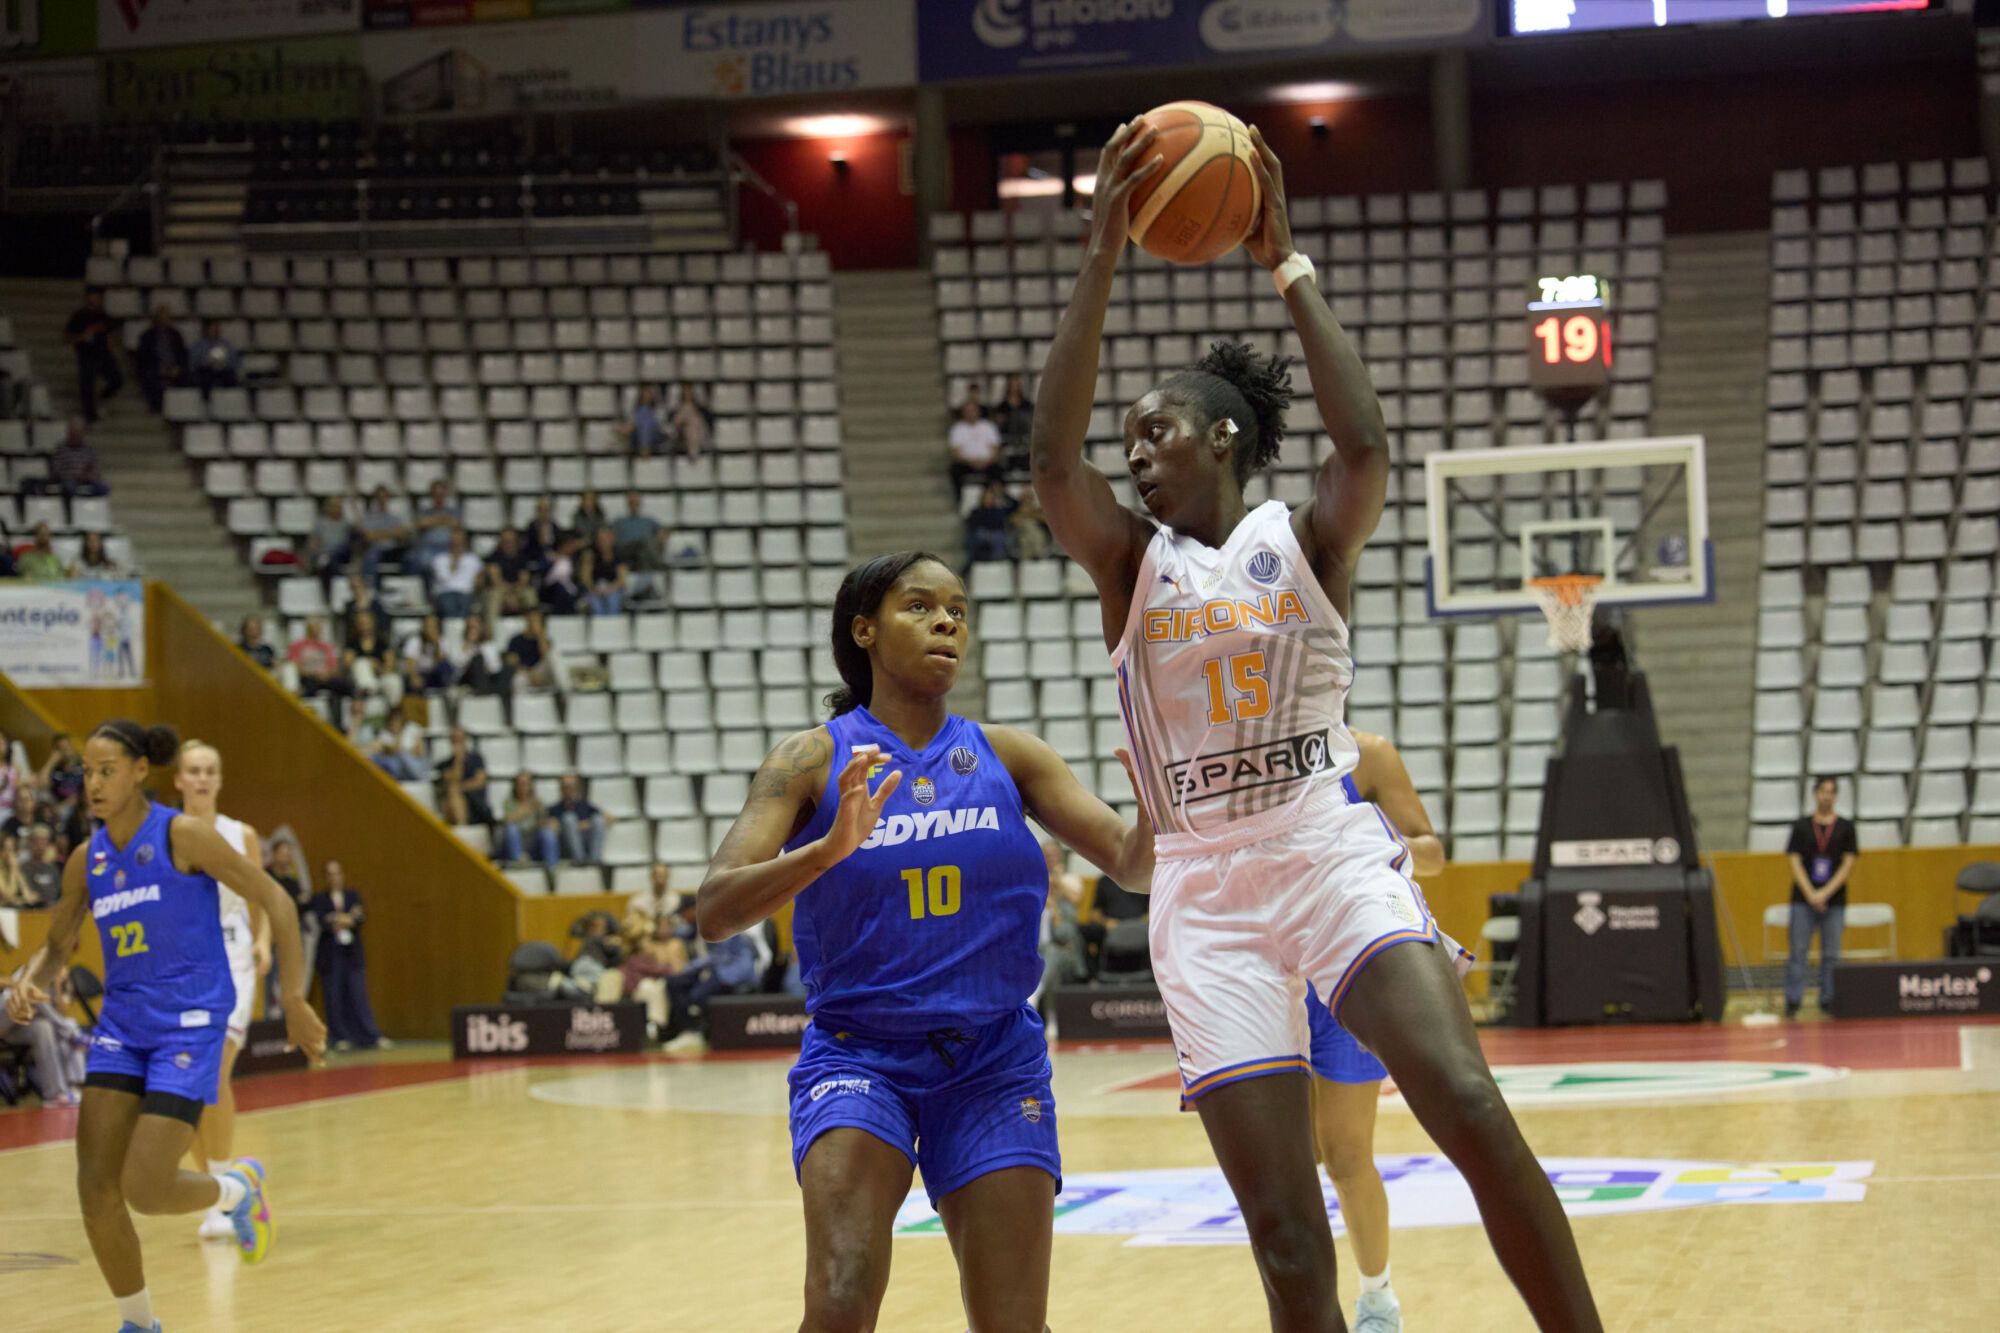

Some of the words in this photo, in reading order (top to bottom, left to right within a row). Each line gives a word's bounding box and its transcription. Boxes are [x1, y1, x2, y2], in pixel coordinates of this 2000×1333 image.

[683, 12, 832, 53] Estanys
[751, 53, 859, 95] Blaus
[1535, 314, 1598, 363] 19
[1143, 589, 1311, 644] GIRONA
[1202, 649, 1272, 727] 15
[1174, 748, 1294, 795] SPAR
[858, 807, 1000, 850] GDYNIA
[93, 884, 160, 920] GDYNIA
[901, 864, 961, 920] 10
[110, 920, 149, 958] 22
[466, 1013, 529, 1052] ibis
[571, 1005, 615, 1031] ibis
